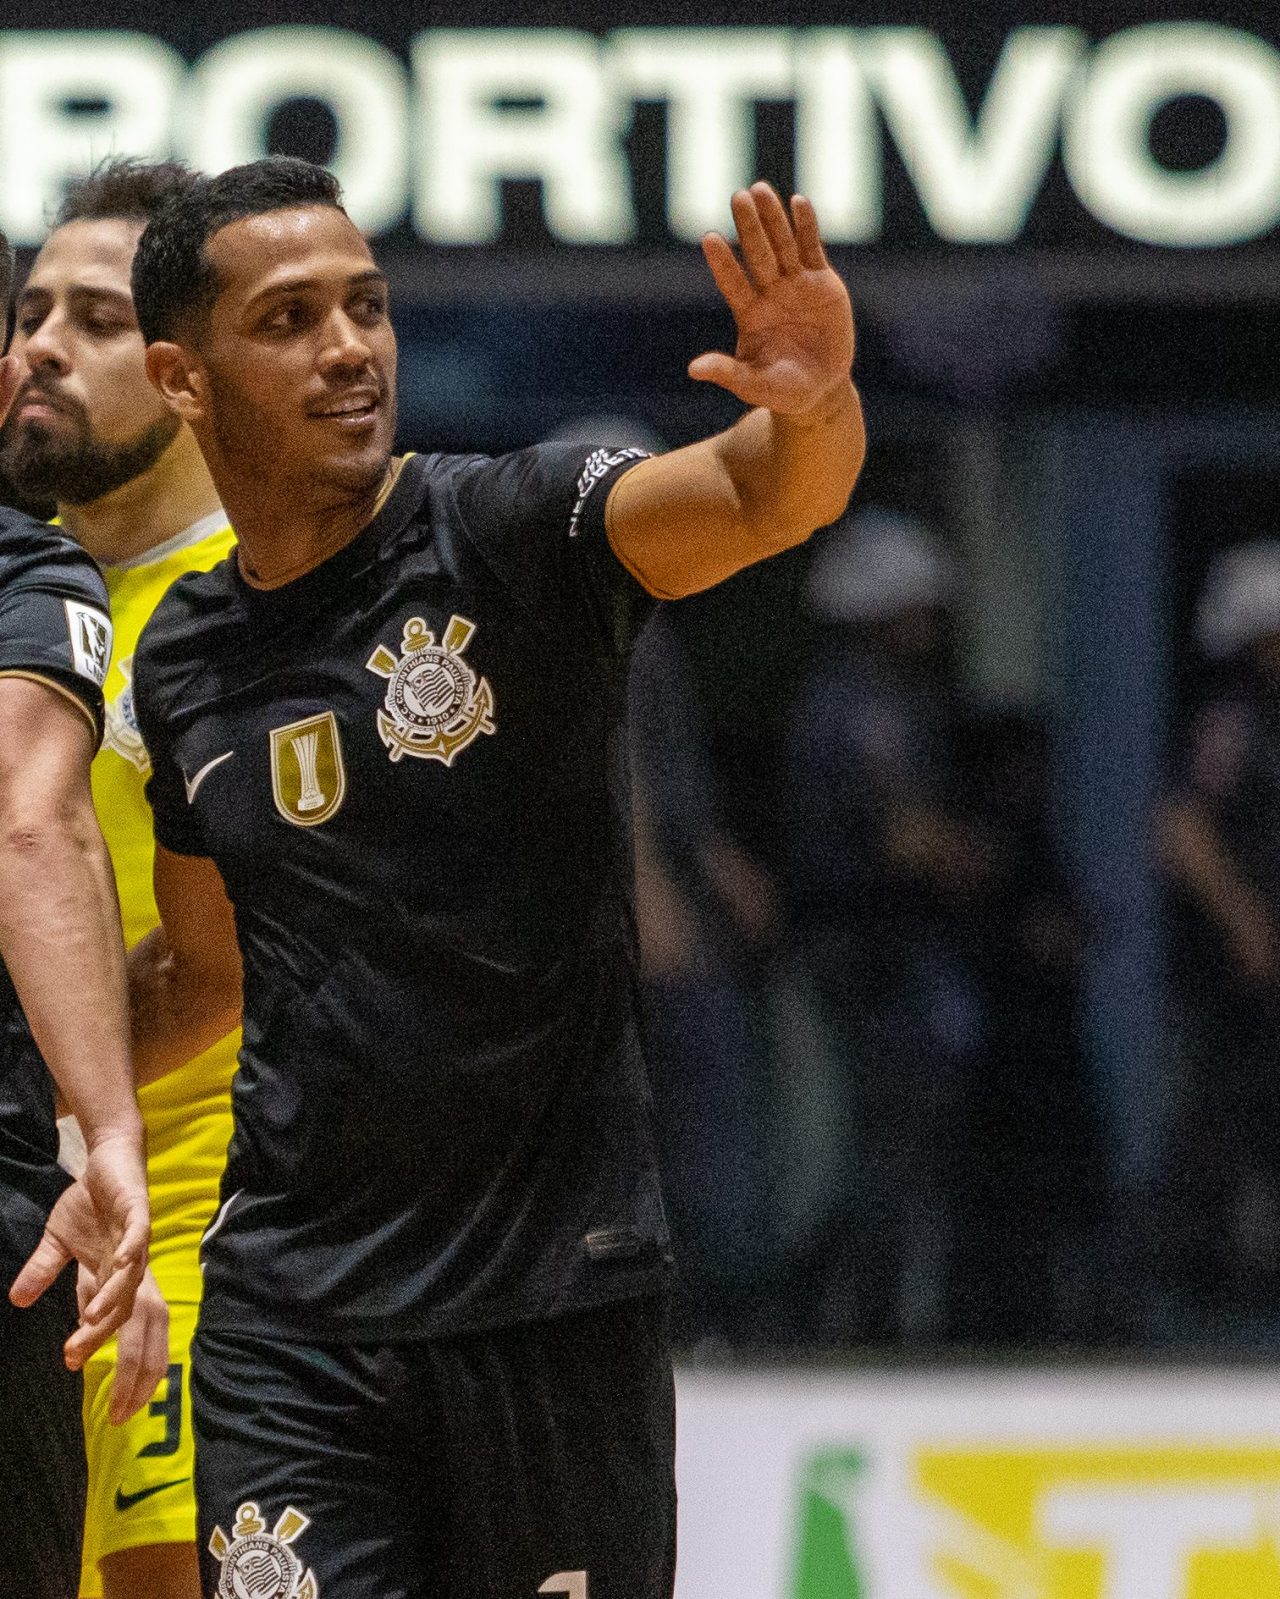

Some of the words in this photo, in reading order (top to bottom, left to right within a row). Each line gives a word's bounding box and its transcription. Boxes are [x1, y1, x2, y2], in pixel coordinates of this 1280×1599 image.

[395, 654, 440, 704] CORINTHIANS
[441, 657, 465, 705] PAULISTA
[425, 712, 450, 726] 1910
[135, 1363, 183, 1458] 3
